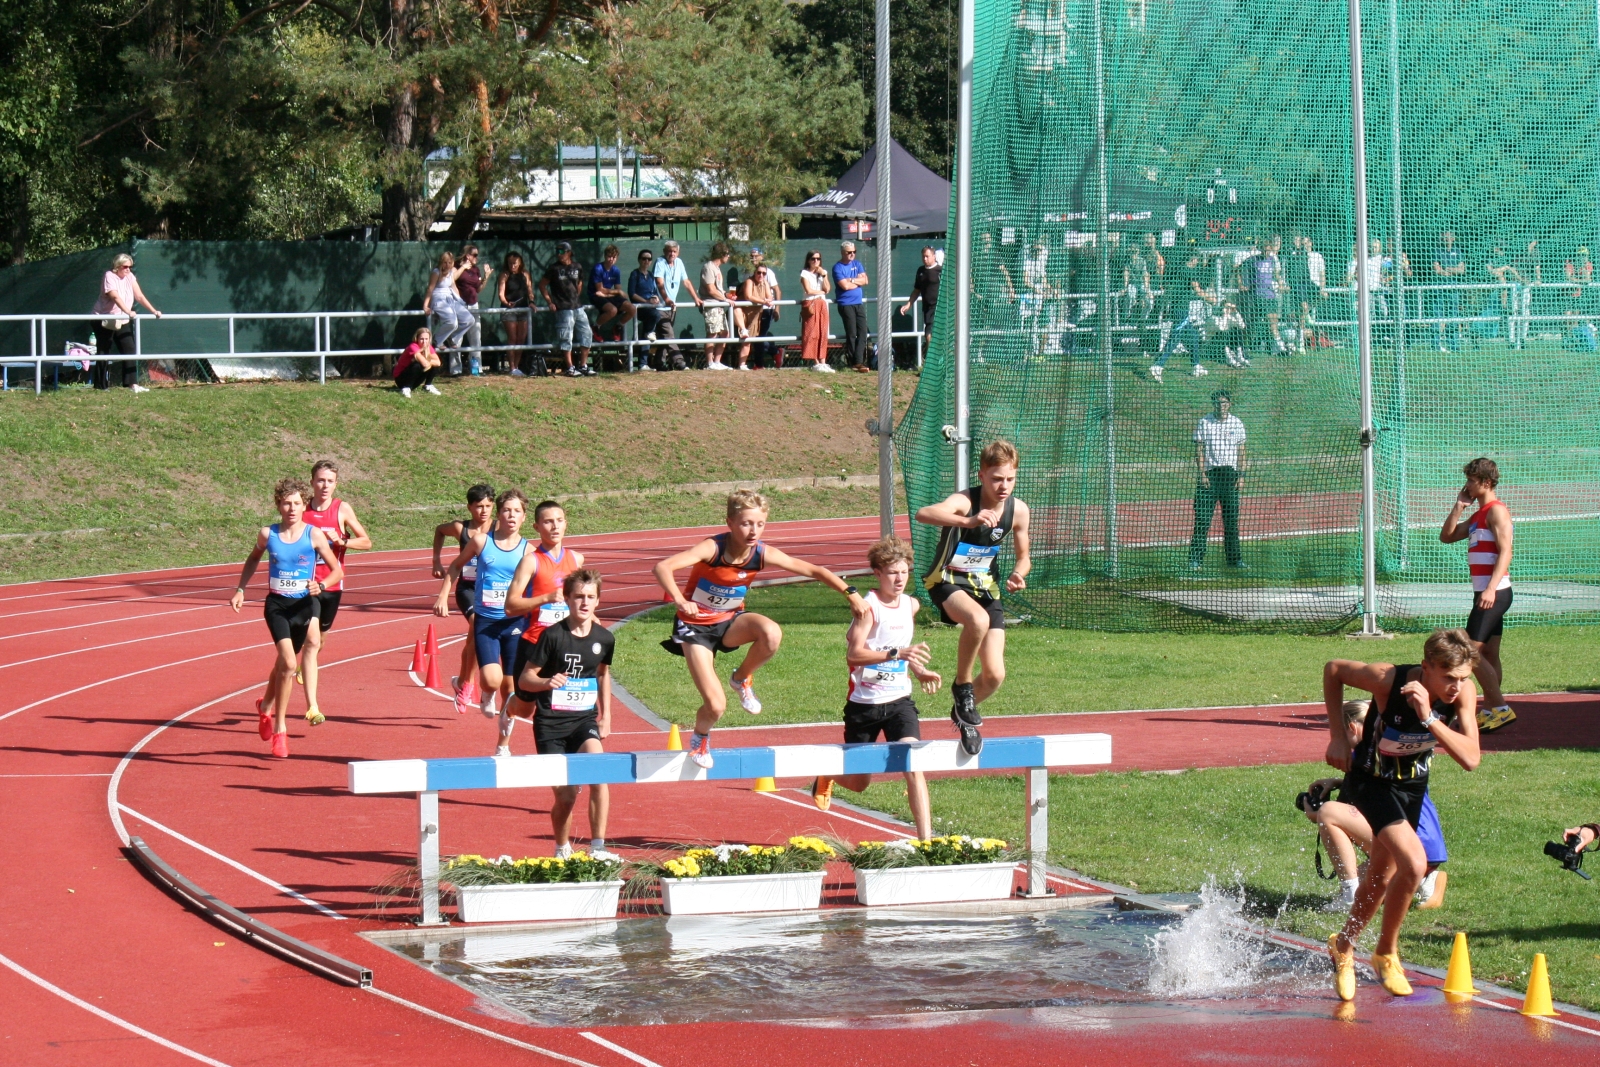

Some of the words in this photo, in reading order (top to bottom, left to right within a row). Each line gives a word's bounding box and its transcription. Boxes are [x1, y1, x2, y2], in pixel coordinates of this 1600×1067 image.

[963, 556, 983, 565] 264
[279, 579, 297, 588] 586
[493, 590, 506, 599] 34
[707, 595, 730, 606] 427
[876, 671, 895, 681] 525
[566, 692, 586, 701] 537
[1396, 742, 1422, 750] 263
